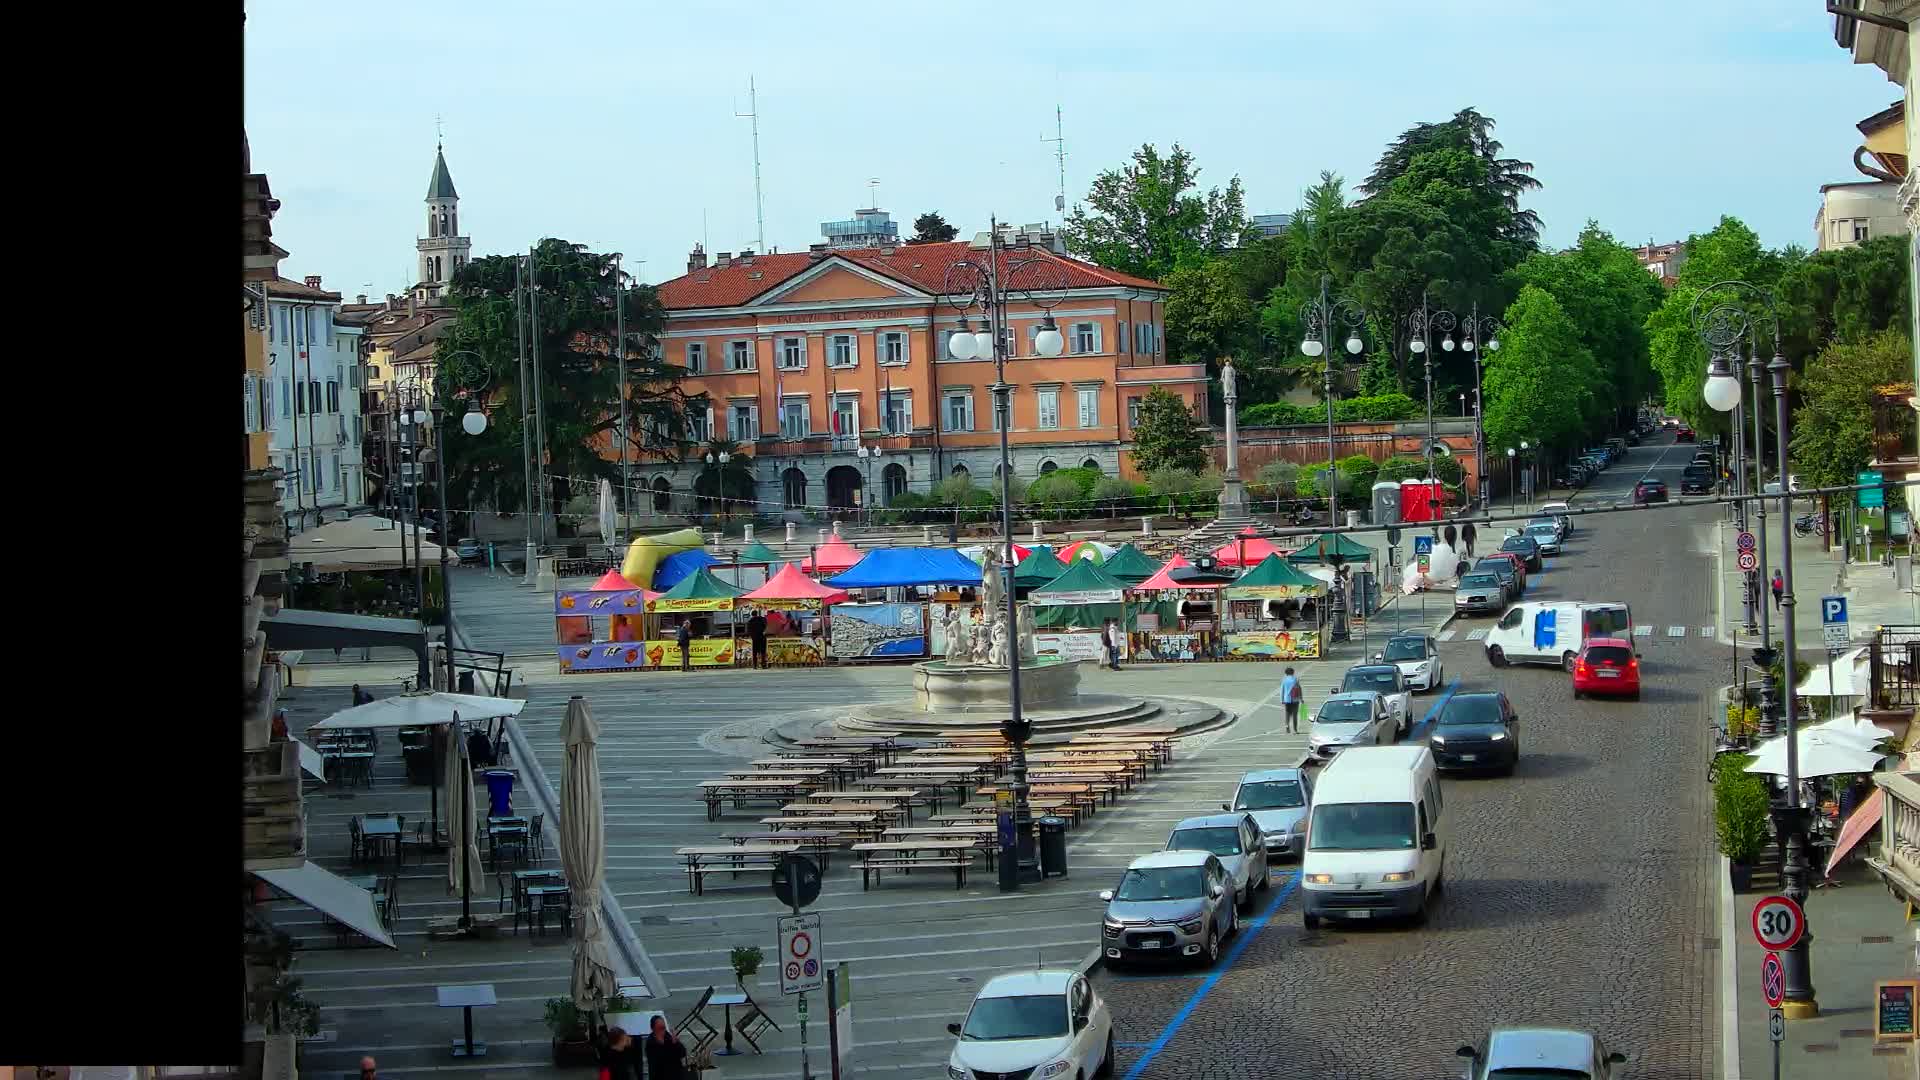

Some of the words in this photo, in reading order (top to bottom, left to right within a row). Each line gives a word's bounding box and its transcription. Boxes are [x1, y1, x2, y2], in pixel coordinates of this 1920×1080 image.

[1742, 556, 1753, 566] 20
[1826, 600, 1842, 621] P
[1762, 910, 1791, 936] 30
